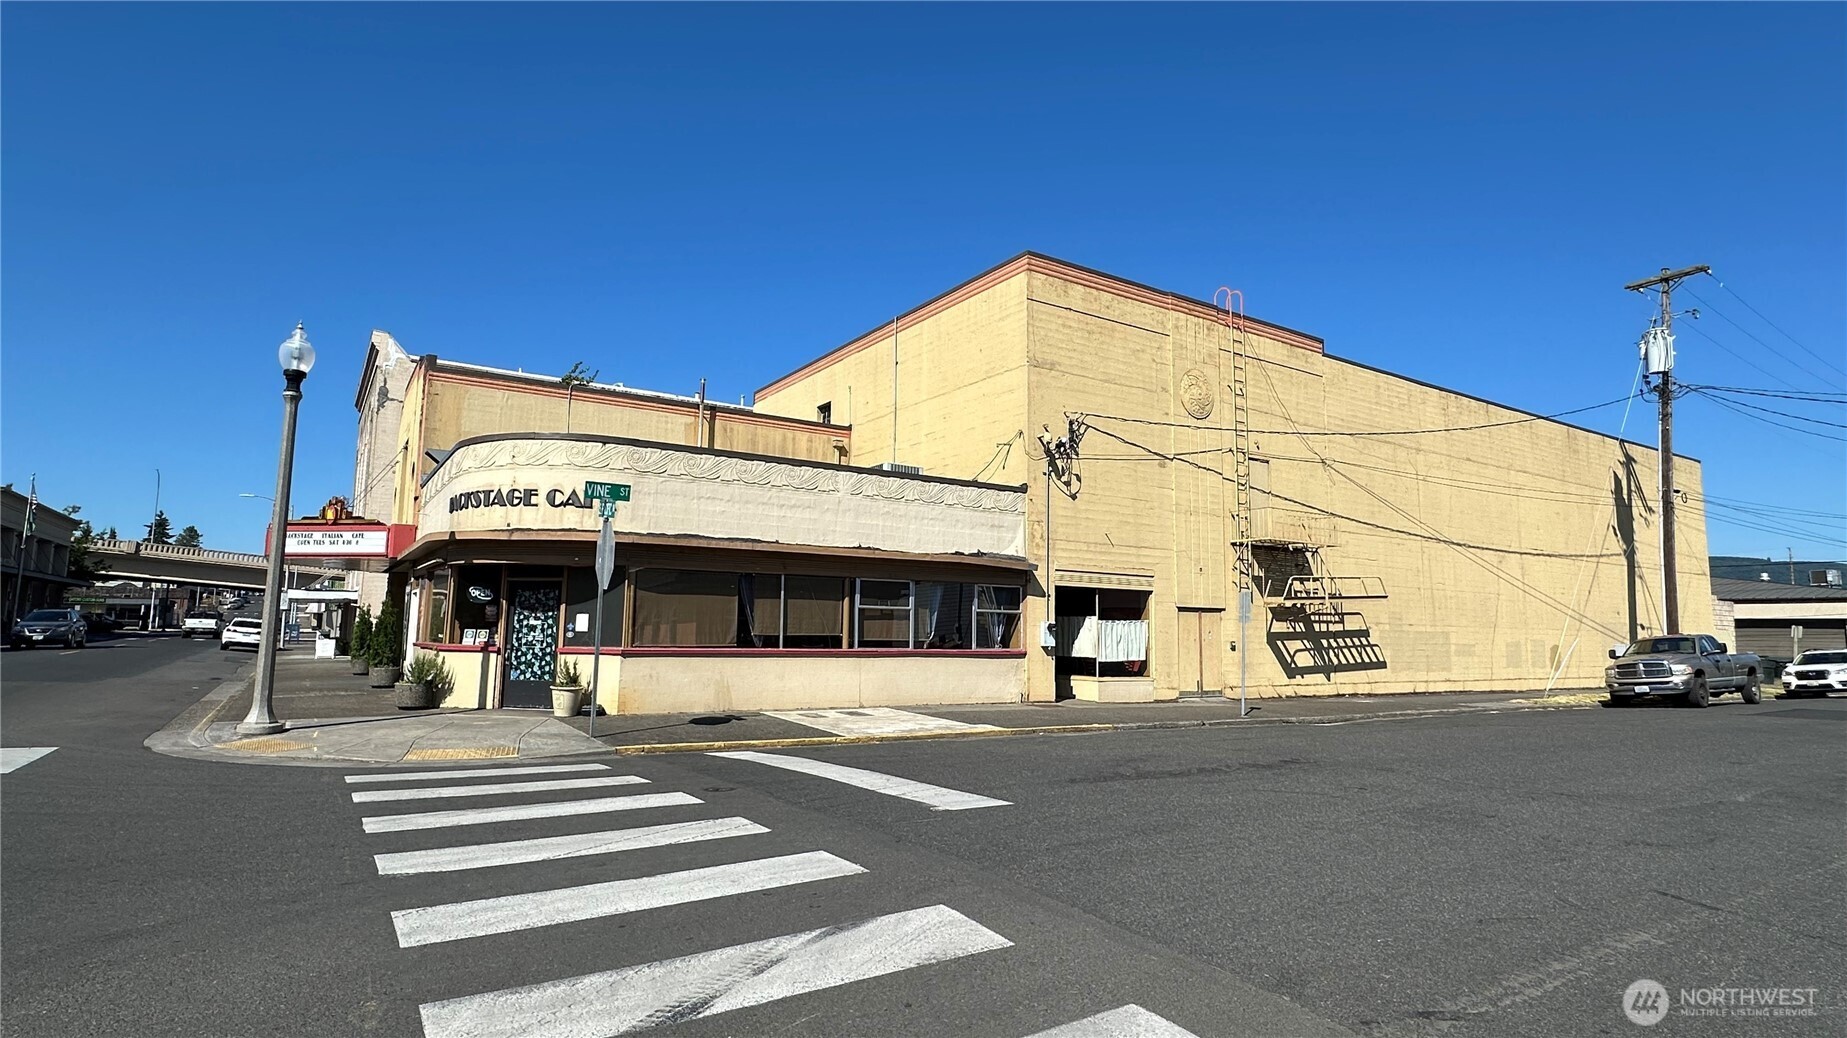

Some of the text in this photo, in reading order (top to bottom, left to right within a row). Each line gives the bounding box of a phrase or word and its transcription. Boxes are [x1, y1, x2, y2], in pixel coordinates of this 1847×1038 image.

[586, 483, 630, 498] VINE ST
[470, 588, 492, 597] OPEN
